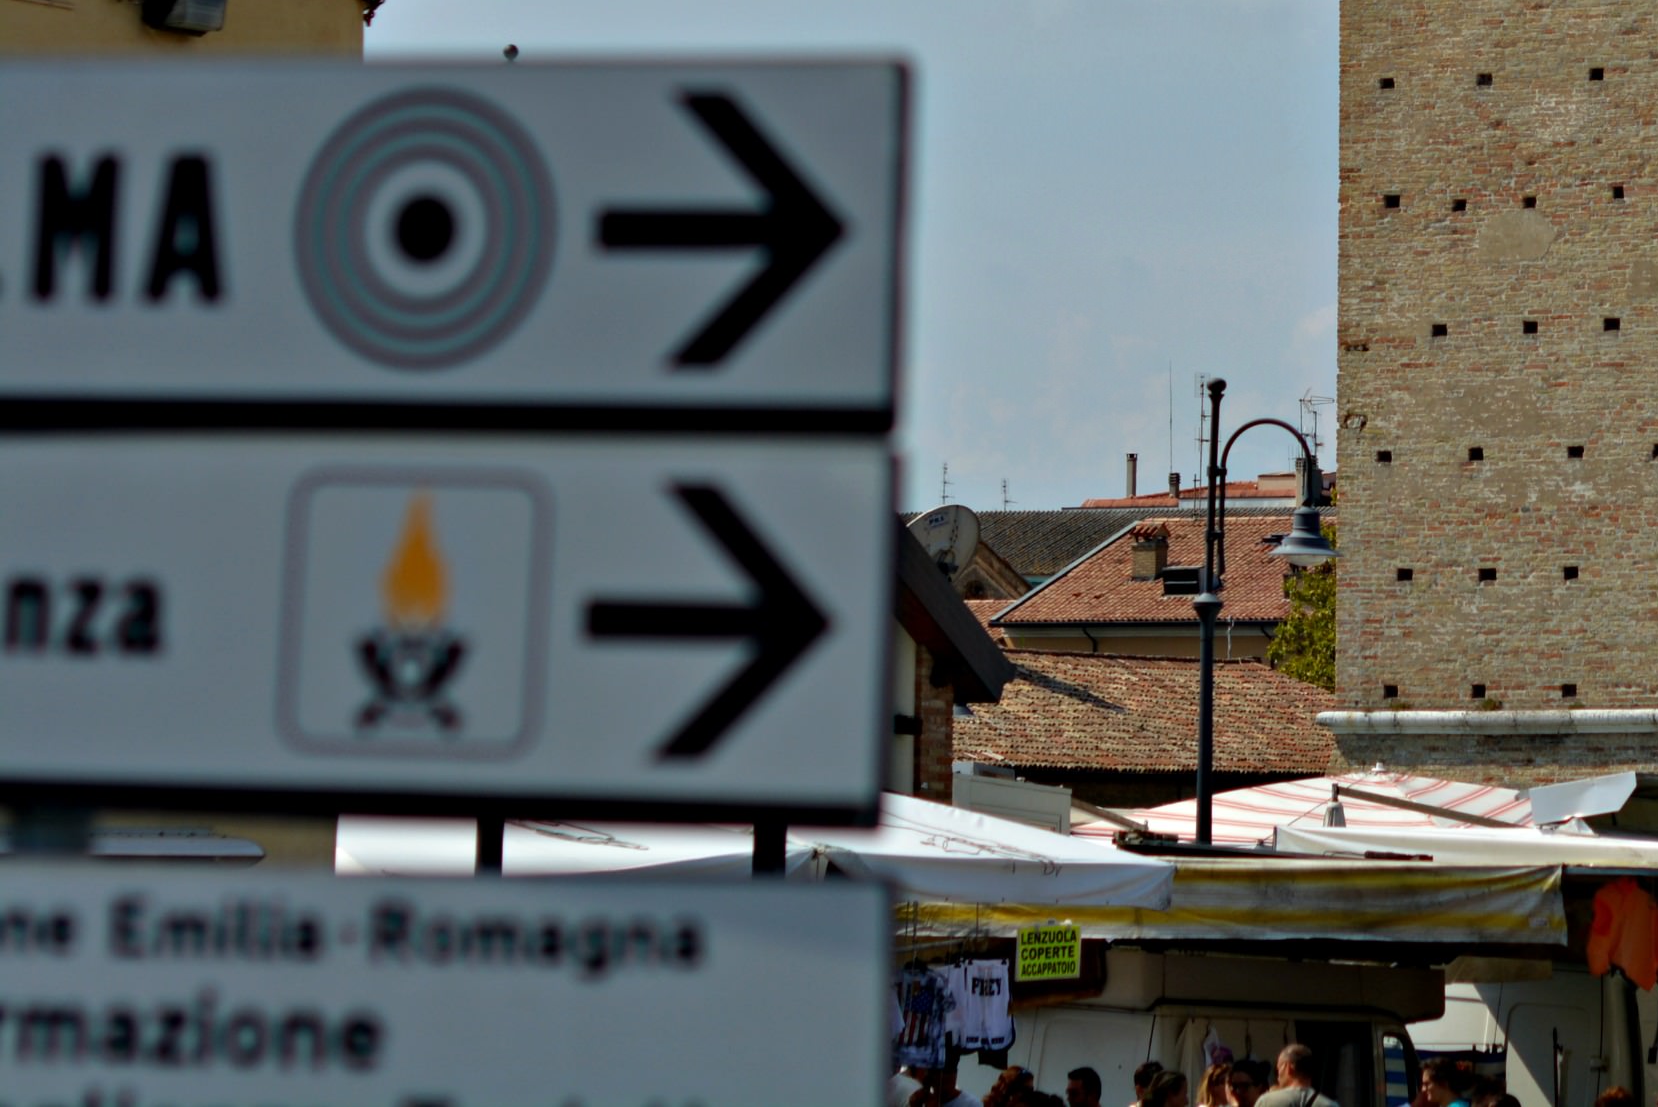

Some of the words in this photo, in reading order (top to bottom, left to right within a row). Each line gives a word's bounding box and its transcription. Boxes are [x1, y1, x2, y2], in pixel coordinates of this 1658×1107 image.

[2, 575, 164, 656] nza
[1021, 929, 1077, 946] LENZUOLA
[1021, 944, 1075, 961] COPERTE
[1021, 961, 1076, 976] ACCAPPATOIO
